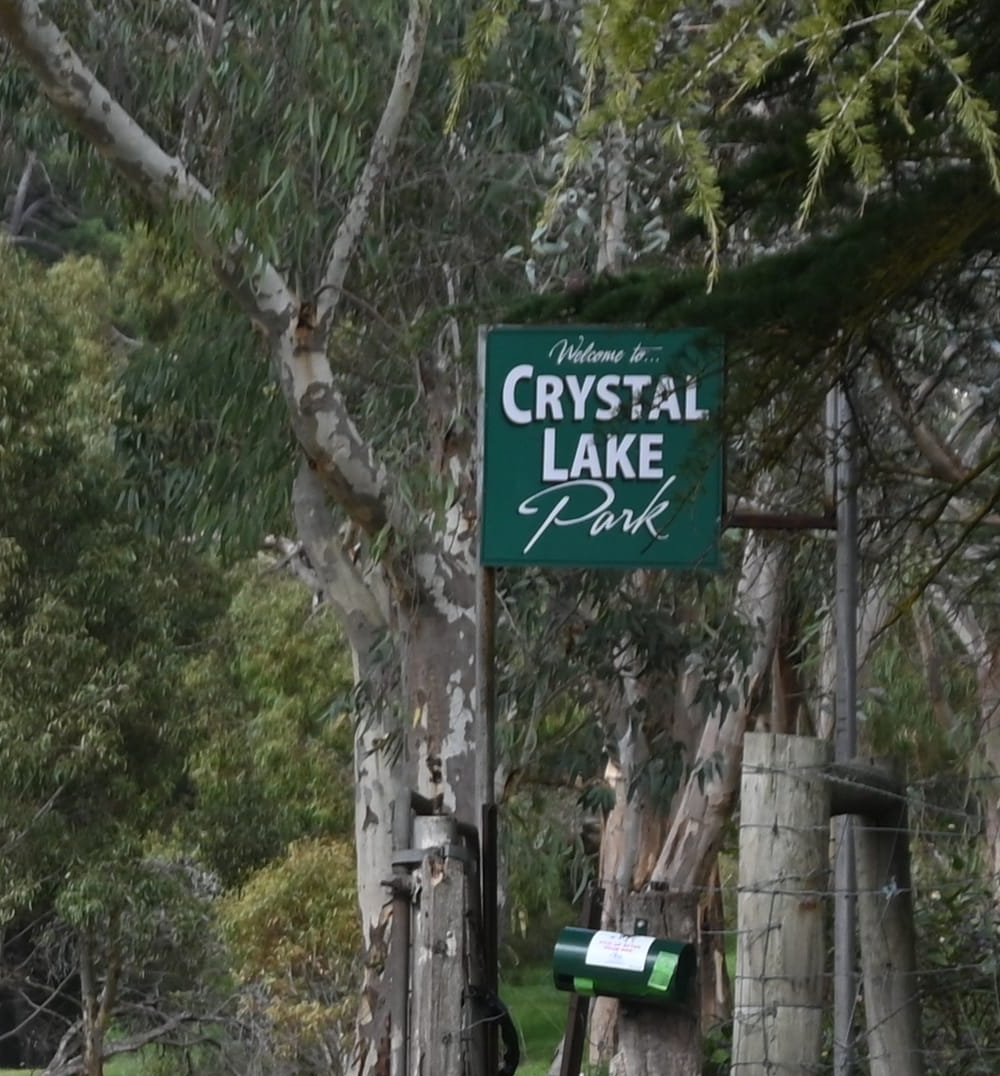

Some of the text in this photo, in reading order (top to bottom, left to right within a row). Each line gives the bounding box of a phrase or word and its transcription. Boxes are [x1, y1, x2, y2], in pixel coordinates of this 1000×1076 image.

[549, 335, 623, 364] Welcome
[502, 364, 709, 424] CRYSTAL
[542, 427, 664, 481] LAKE
[518, 475, 676, 554] Park
